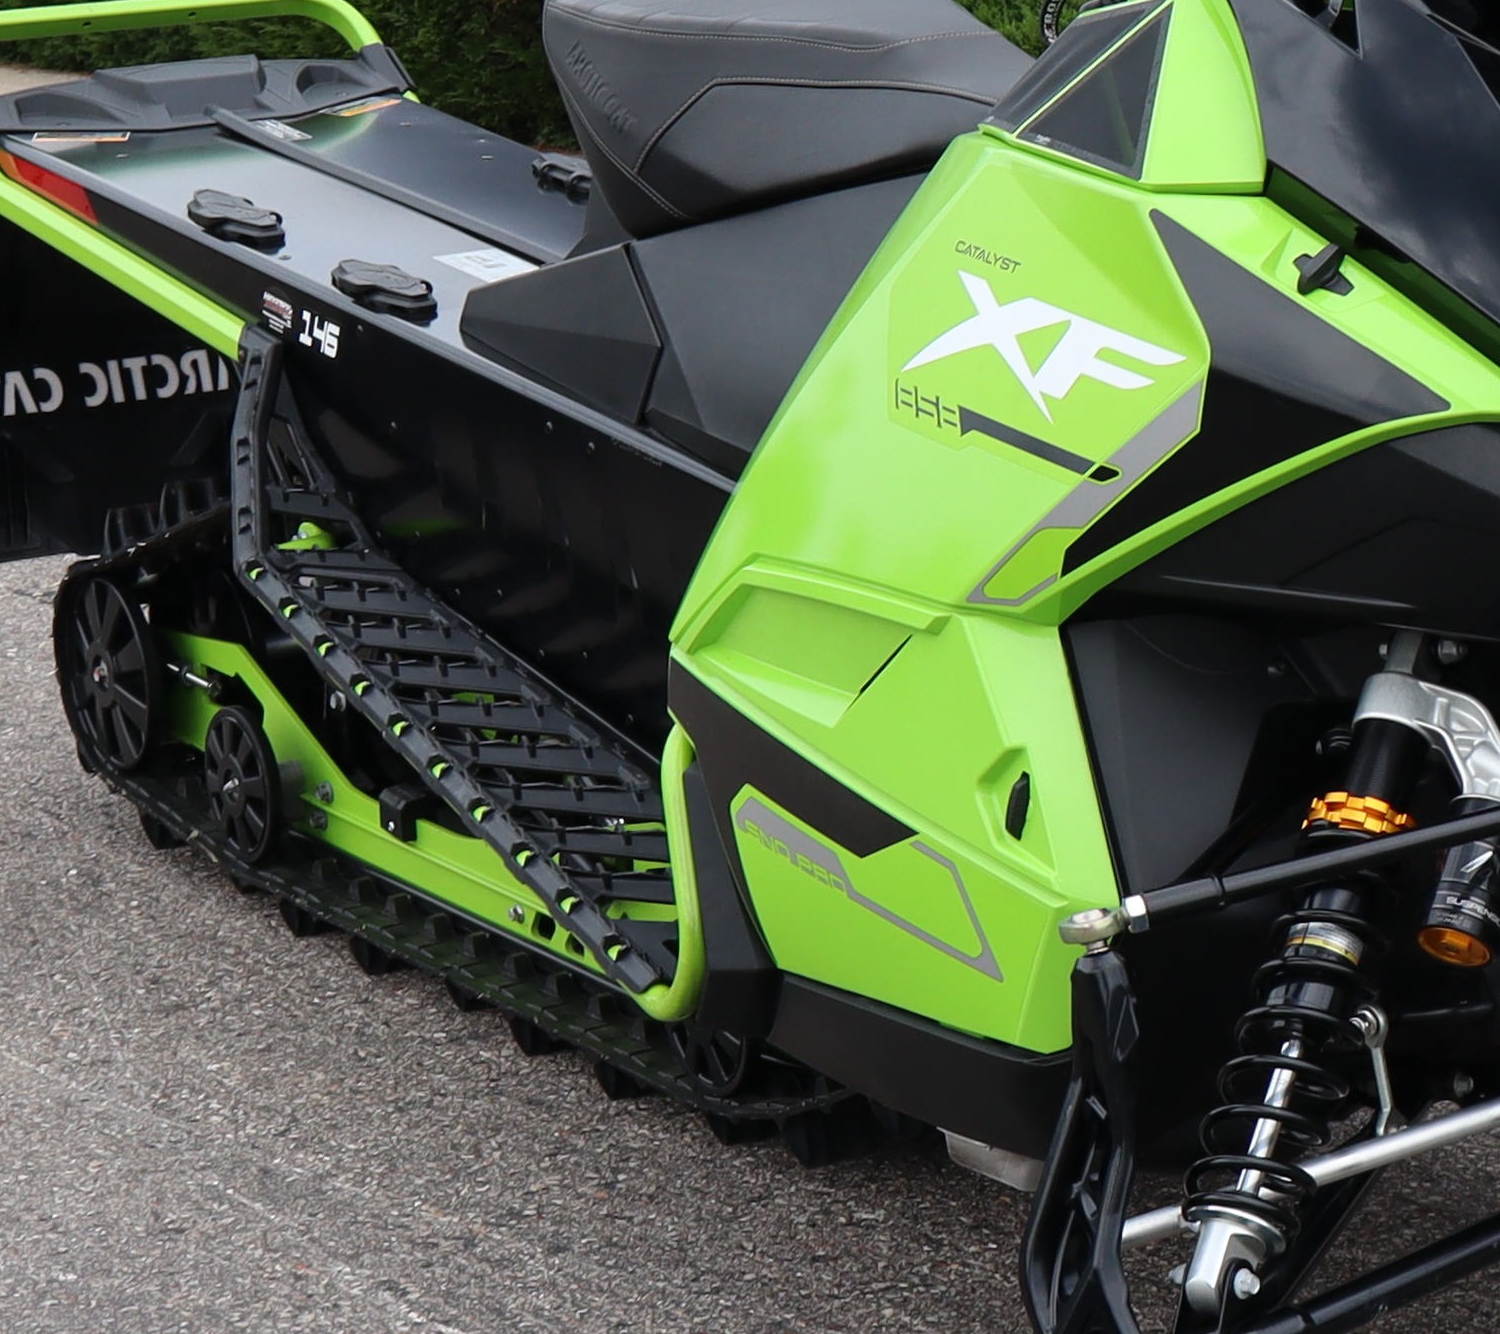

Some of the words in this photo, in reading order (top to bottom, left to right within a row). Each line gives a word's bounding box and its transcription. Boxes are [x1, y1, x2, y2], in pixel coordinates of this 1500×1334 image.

[953, 239, 1022, 274] CATALYST
[298, 309, 341, 359] 146
[901, 269, 1188, 425] XF
